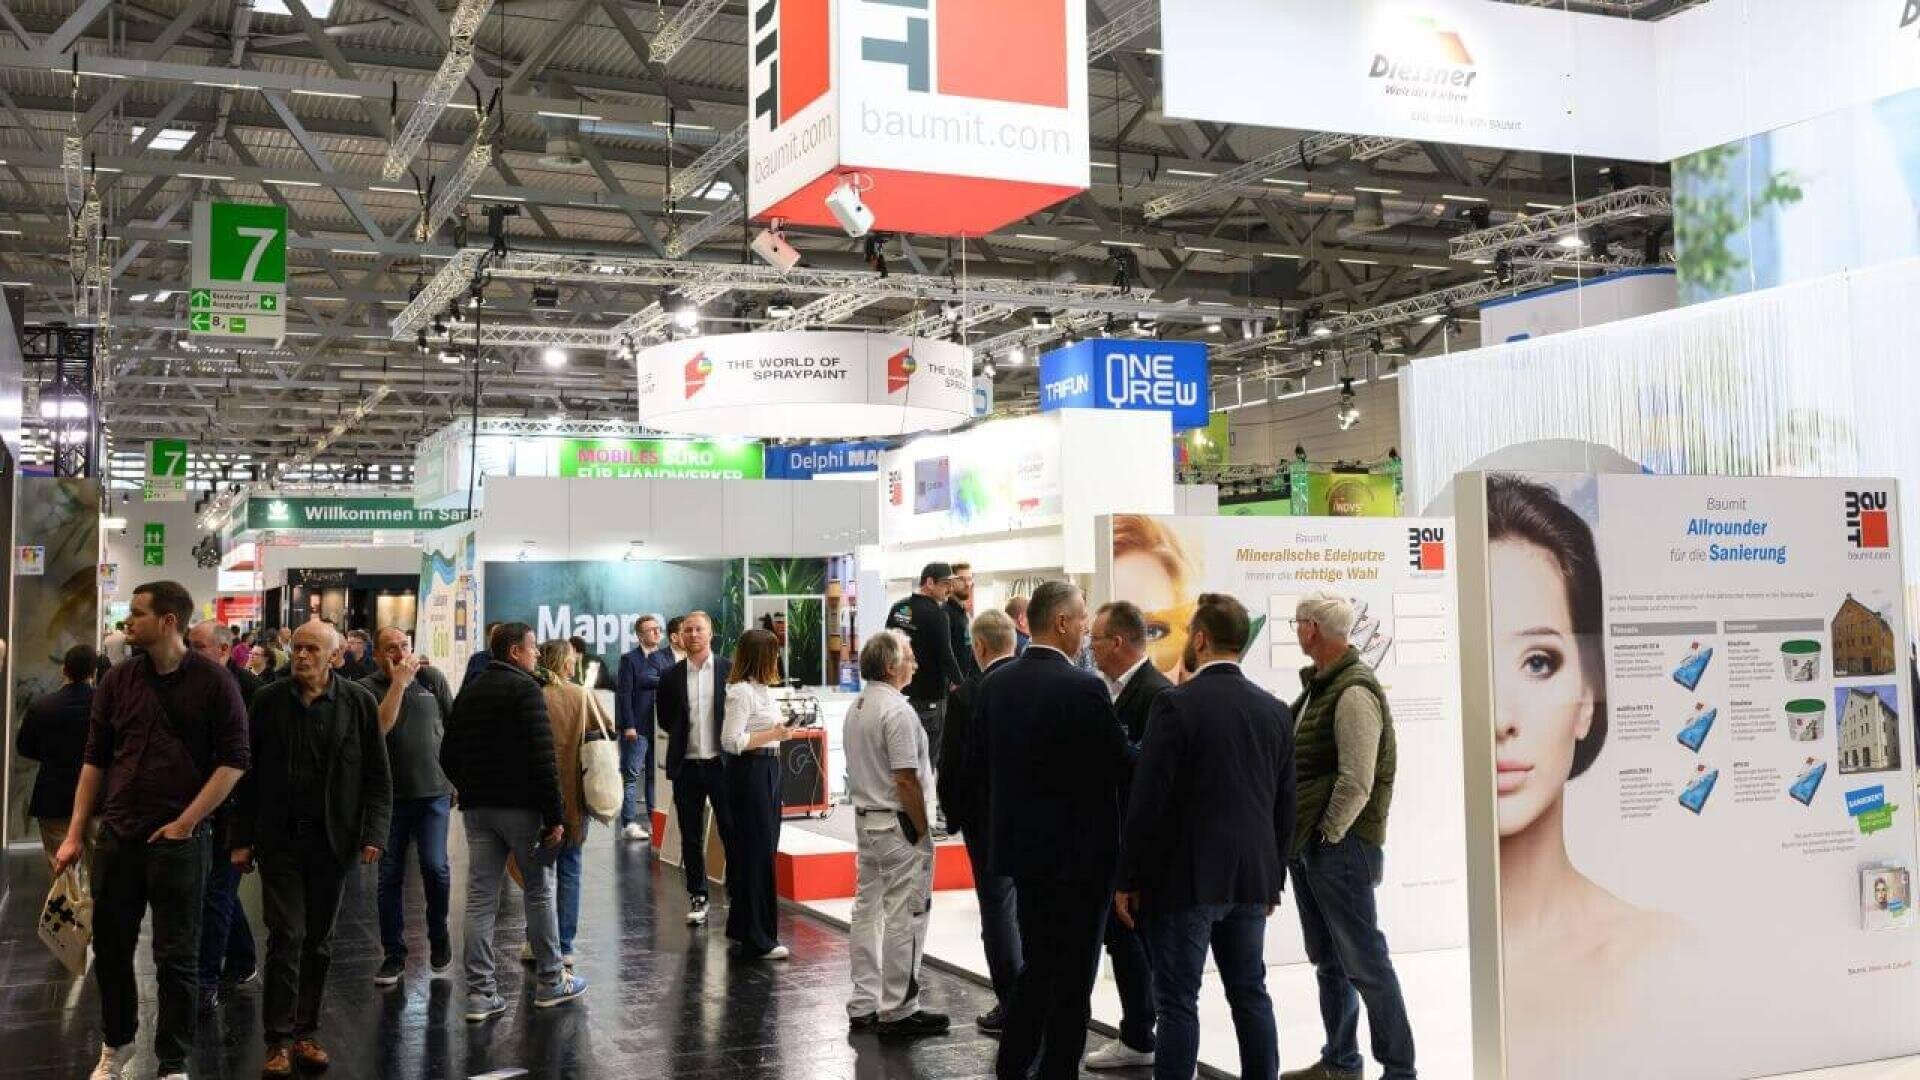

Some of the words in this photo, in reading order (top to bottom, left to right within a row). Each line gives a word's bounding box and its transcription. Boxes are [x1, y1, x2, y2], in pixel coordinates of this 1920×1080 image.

[861, 102, 1071, 155] baumit.com
[756, 113, 832, 184] baumit.com
[236, 226, 278, 284] 7
[727, 360, 754, 371] THE
[759, 357, 814, 368] WORLD
[820, 357, 841, 367] OF
[752, 369, 848, 381] SPRAYPAINT
[1045, 374, 1089, 400] TAIFUN
[164, 451, 184, 477] 7
[578, 449, 658, 465] MOBILES
[791, 449, 844, 472] Delphi
[305, 505, 413, 521] Willkommen
[418, 508, 433, 520] in
[1706, 497, 1747, 511] Baumit
[1687, 518, 1768, 536] Allrounder
[1236, 549, 1321, 562] Mineralische
[1324, 548, 1386, 563] Edelputze
[1670, 548, 1686, 562] für
[1688, 547, 1706, 562] die
[1709, 543, 1787, 565] Sanierung
[1295, 566, 1342, 583] richtige
[1346, 566, 1378, 580] Wahl
